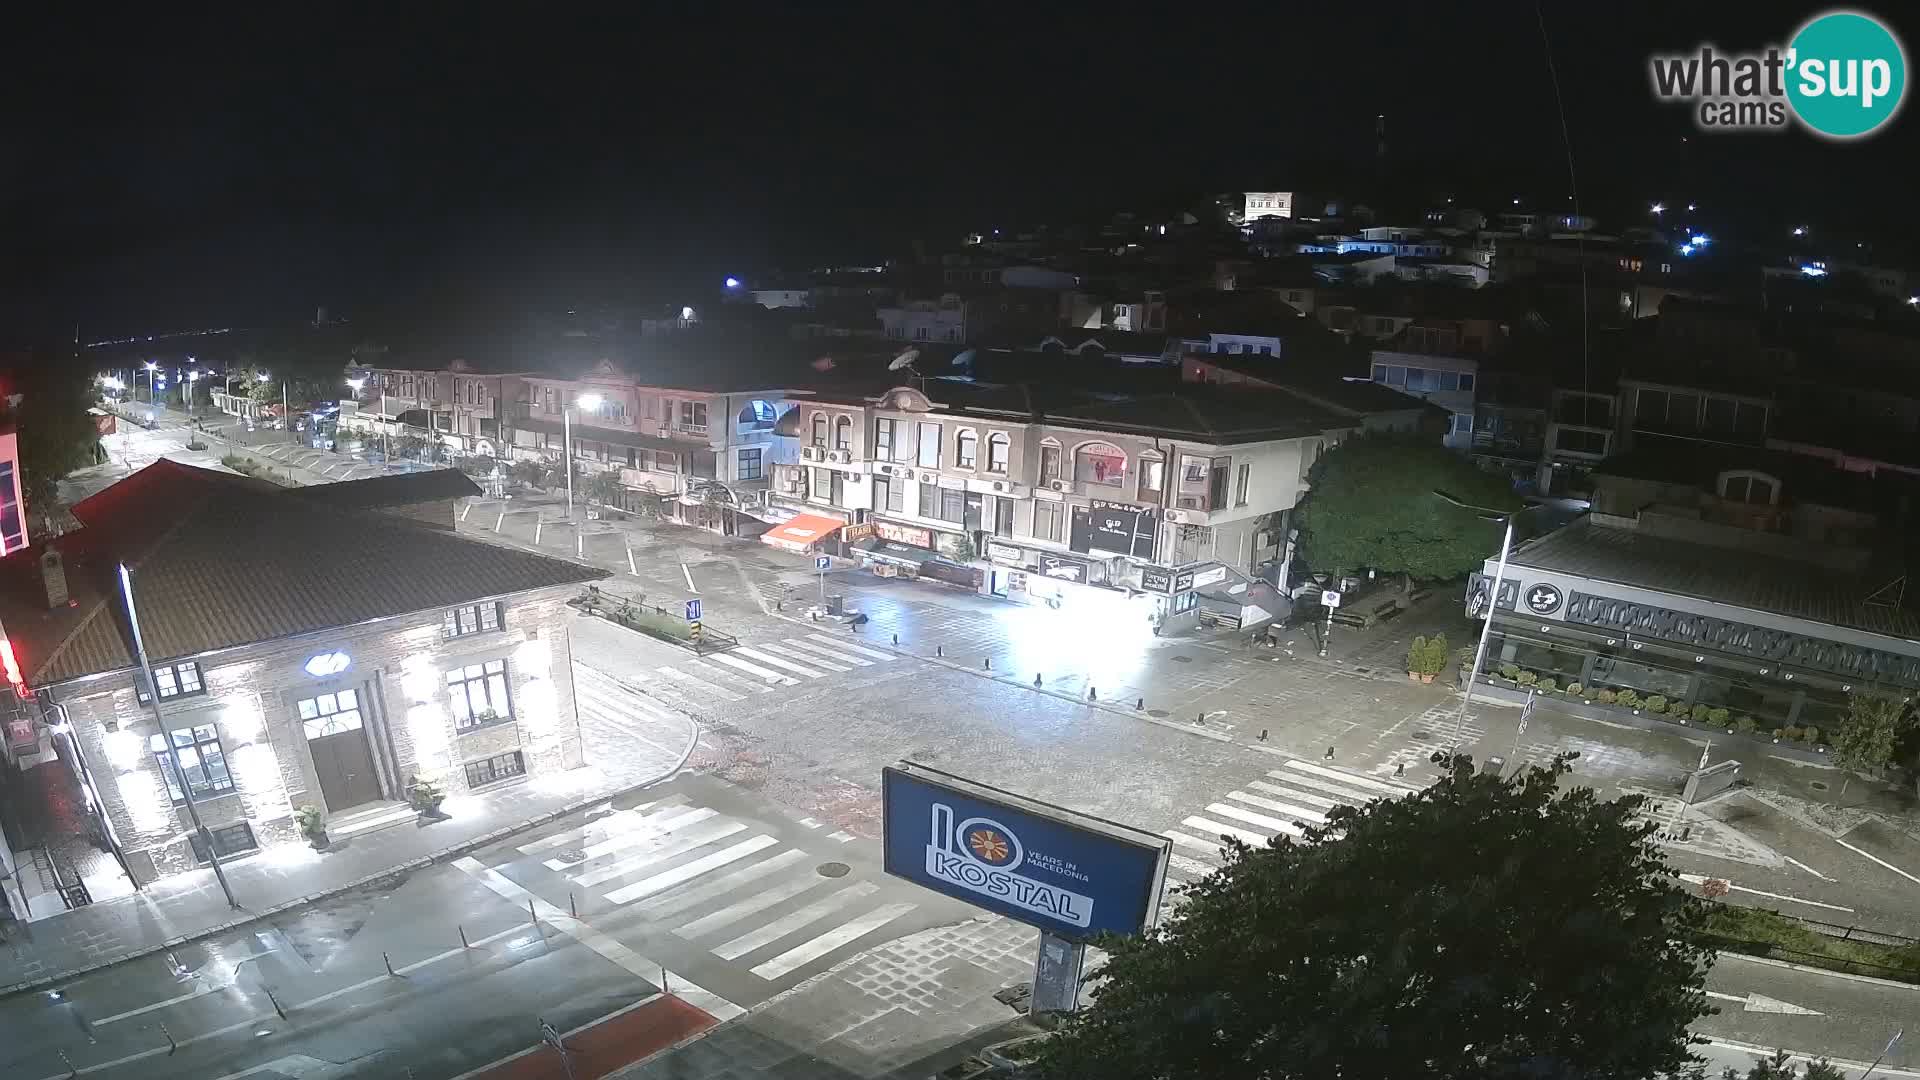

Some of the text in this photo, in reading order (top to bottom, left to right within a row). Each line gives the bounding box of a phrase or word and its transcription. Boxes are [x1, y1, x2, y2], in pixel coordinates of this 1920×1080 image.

[819, 558, 828, 569] P
[1026, 857, 1089, 882] MACEDONIA
[1028, 850, 1077, 871] YEARS IN
[935, 851, 1081, 920] KOSTAL
